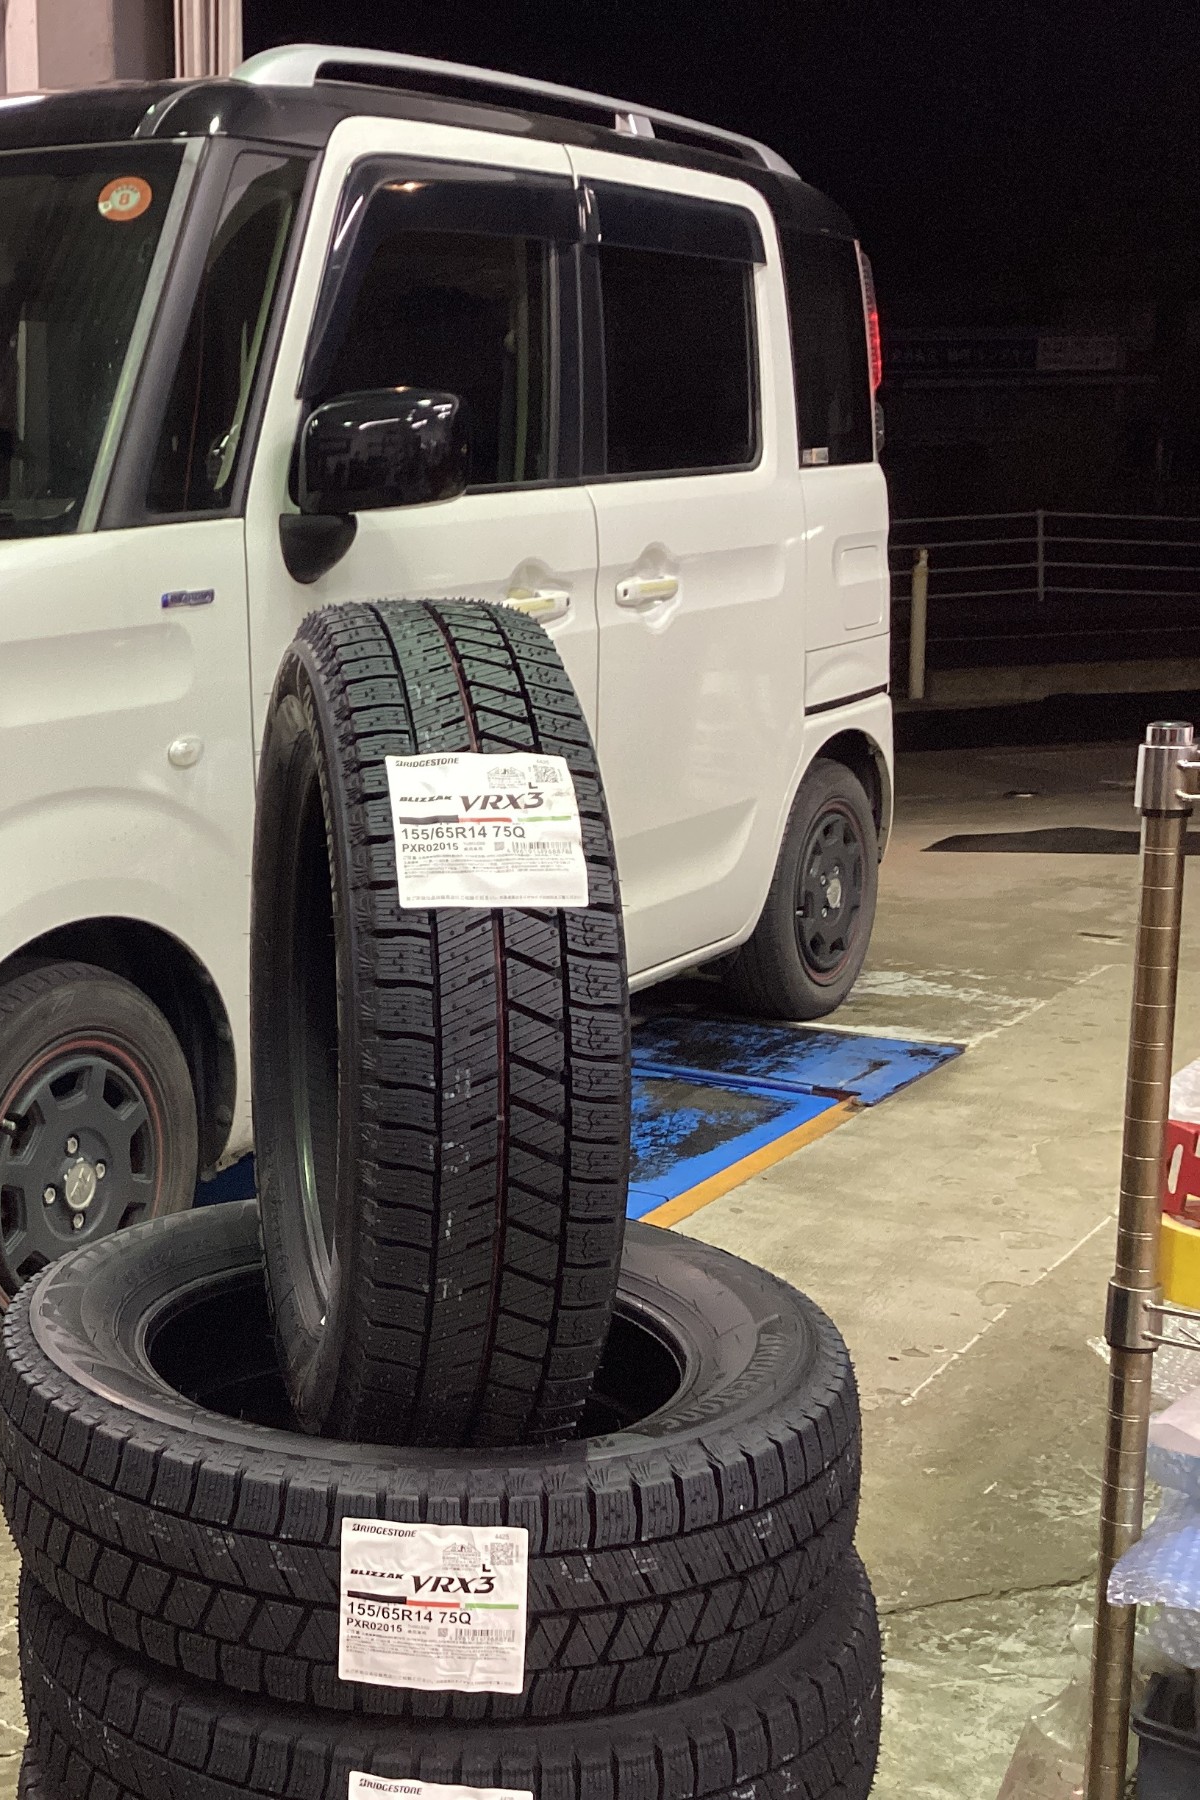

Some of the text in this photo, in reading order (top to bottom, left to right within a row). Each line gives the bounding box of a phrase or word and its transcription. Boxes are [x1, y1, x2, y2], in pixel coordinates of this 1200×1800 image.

[395, 757, 459, 768] BRIDGESTONE
[528, 781, 539, 790] L
[399, 791, 544, 813] BLIZZAK VRX3
[401, 824, 526, 841] 155/65R14 75Q
[402, 842, 459, 853] PXR02015
[352, 1523, 417, 1538] BRIDGESTONE
[482, 1563, 492, 1573] L
[350, 1568, 496, 1594] BLIZZAK VRX3
[347, 1601, 472, 1626] 155/65R14 75Q
[346, 1617, 403, 1633] PXR02015
[358, 1778, 423, 1796] BRIDGESTONE
